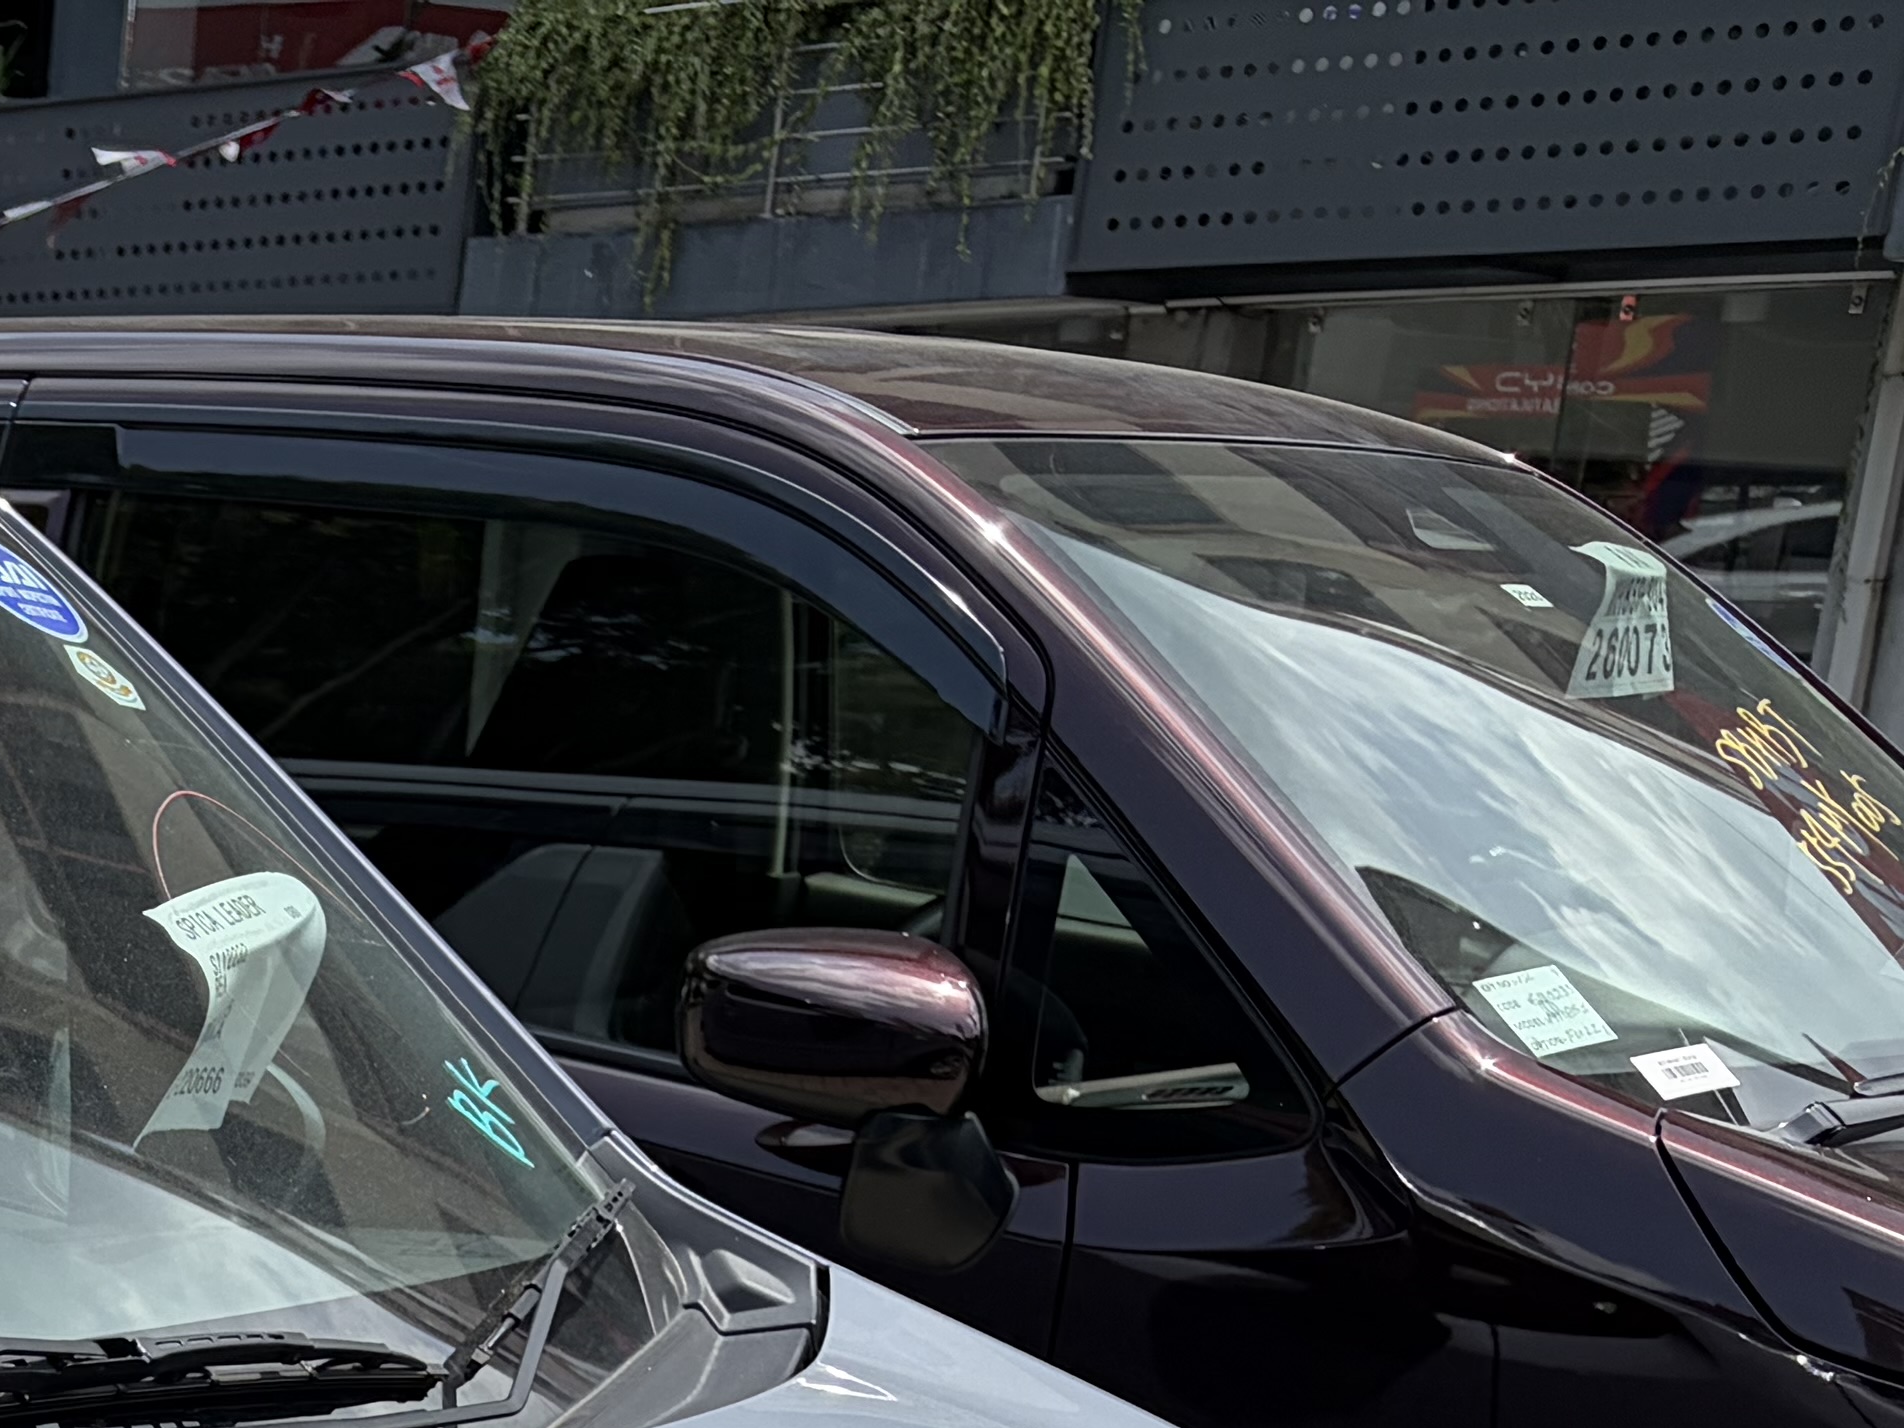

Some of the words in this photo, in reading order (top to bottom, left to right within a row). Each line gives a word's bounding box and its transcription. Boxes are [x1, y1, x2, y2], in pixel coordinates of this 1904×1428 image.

[1586, 623, 1671, 682] 260073
[176, 911, 226, 940] SPICA
[212, 894, 267, 926] LEADER
